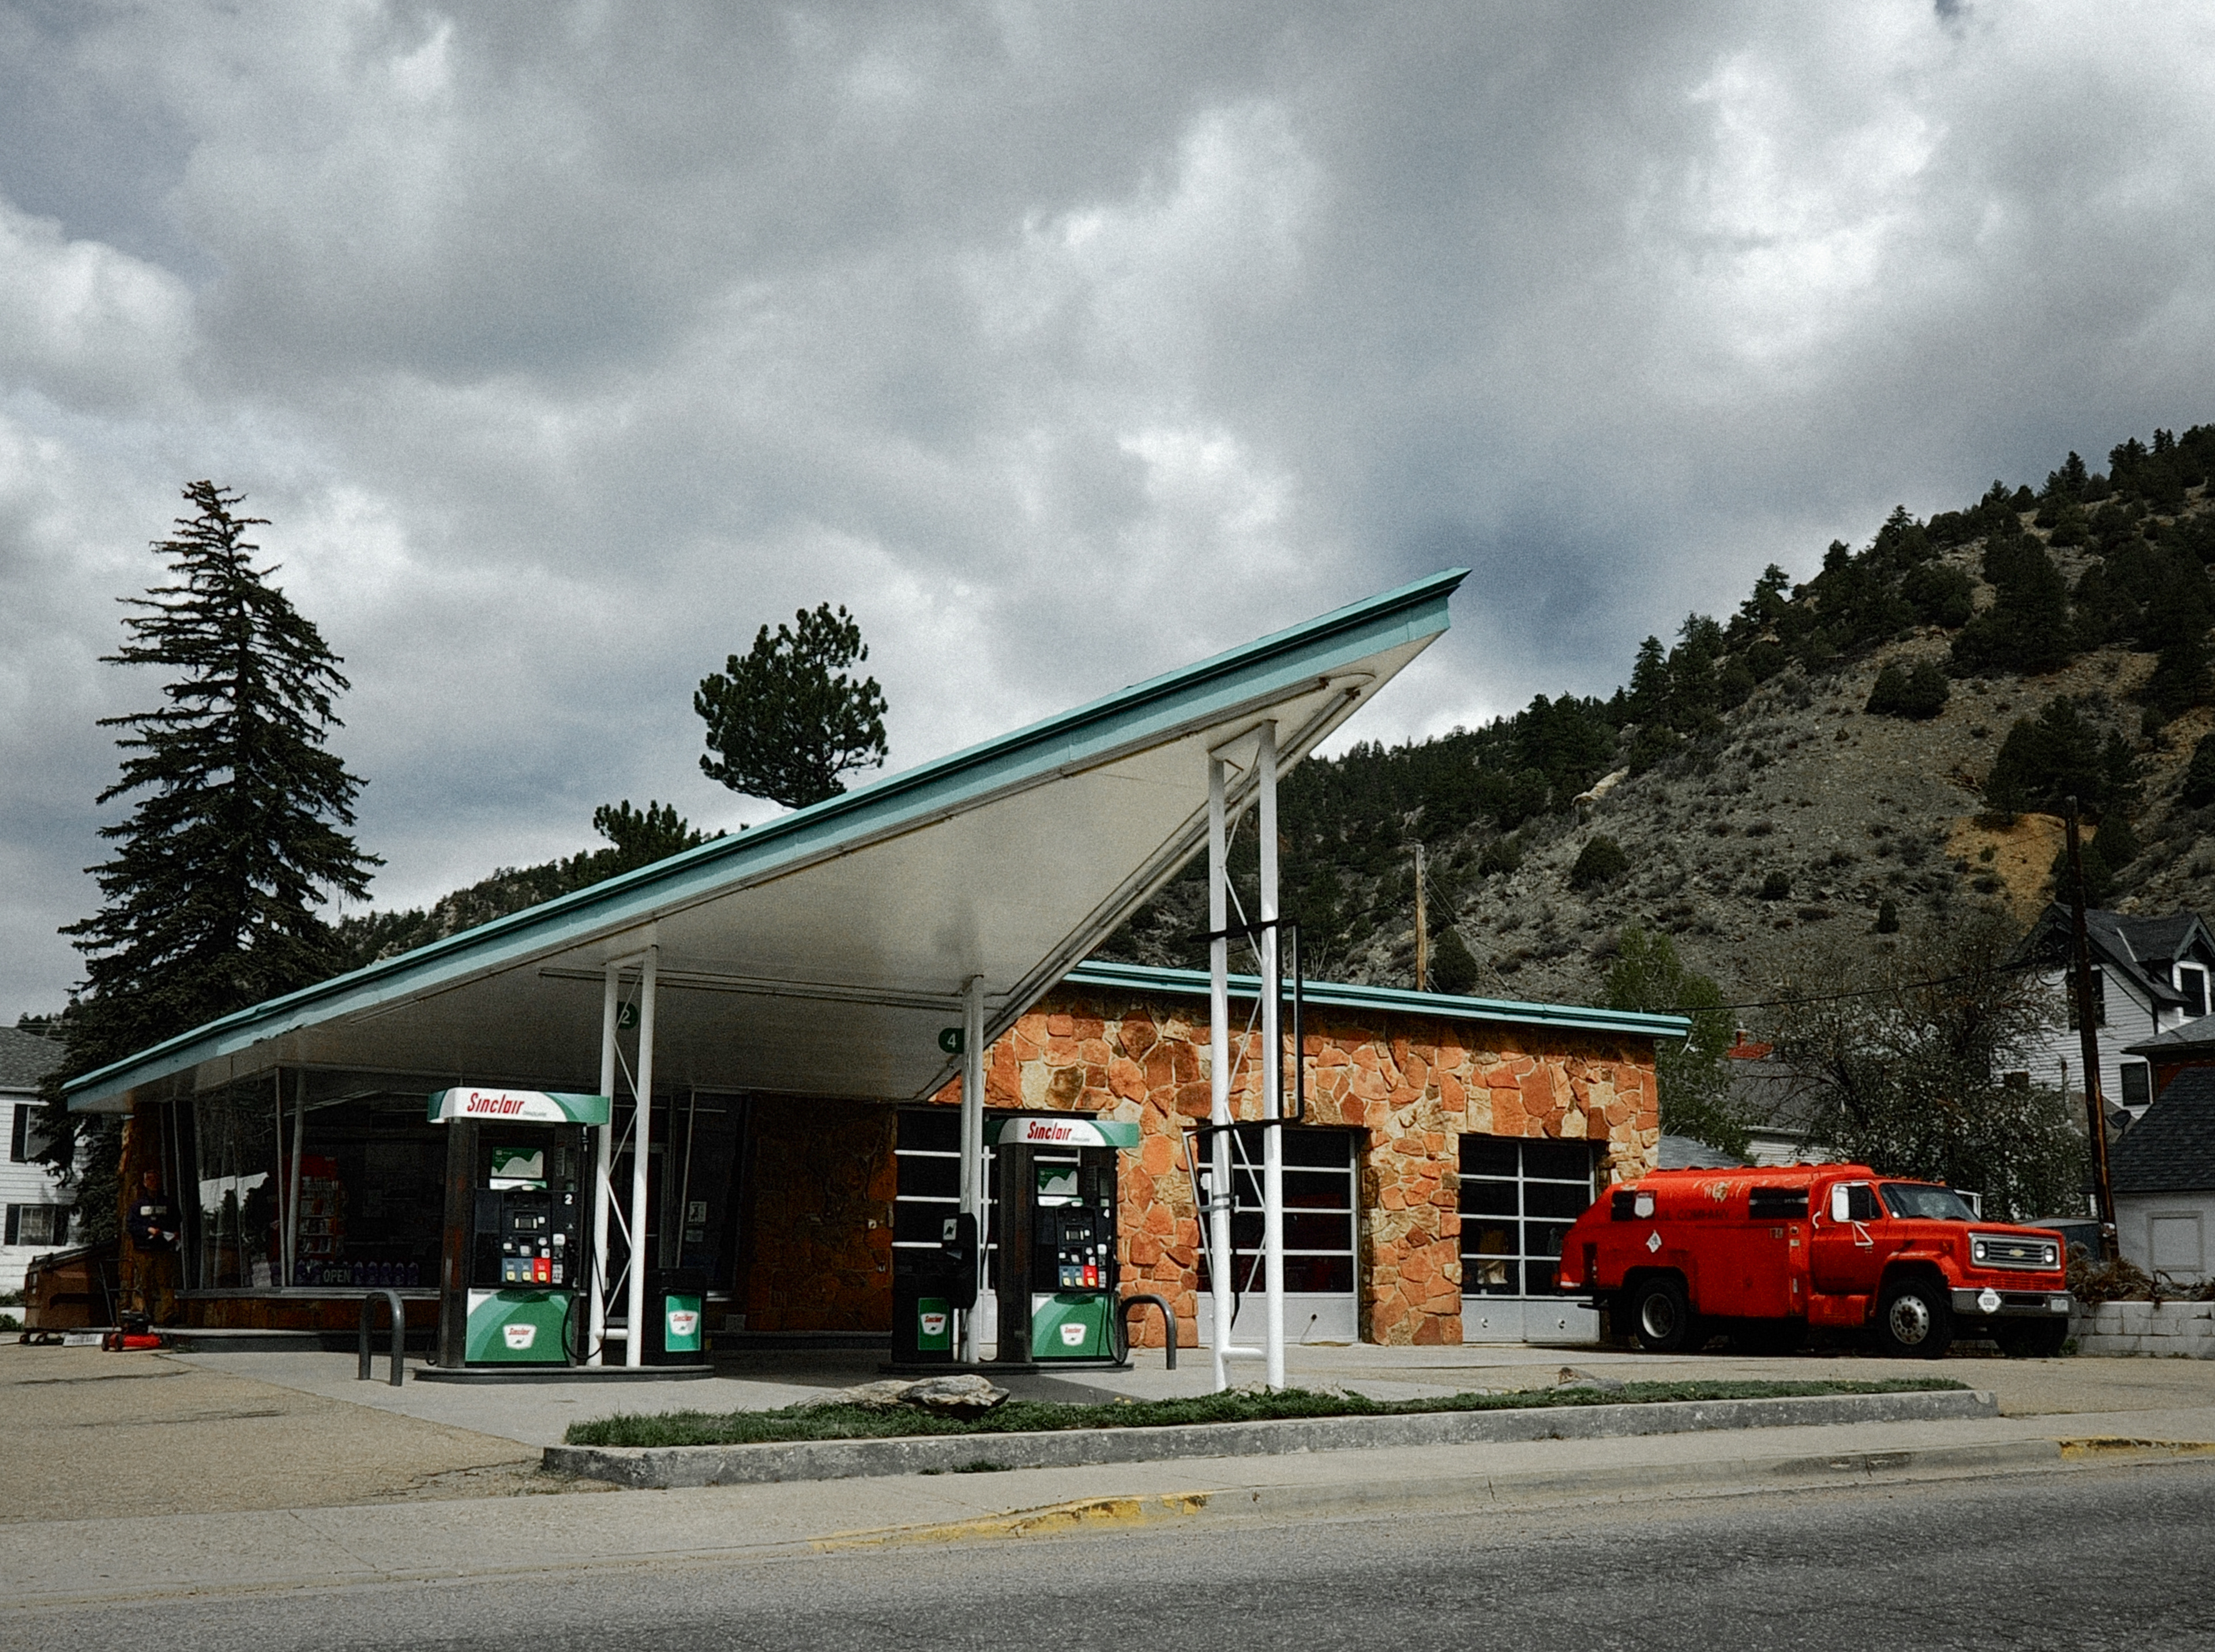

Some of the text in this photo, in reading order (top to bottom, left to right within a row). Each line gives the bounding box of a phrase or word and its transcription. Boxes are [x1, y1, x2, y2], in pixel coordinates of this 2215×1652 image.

[620, 1008, 630, 1024] 2
[947, 1032, 957, 1049] 4
[467, 1092, 525, 1114] Sinclair
[1027, 1121, 1072, 1140] Sinclair
[564, 1193, 573, 1205] 2
[1103, 1208, 1110, 1219] 4
[323, 1268, 351, 1283] OPEN
